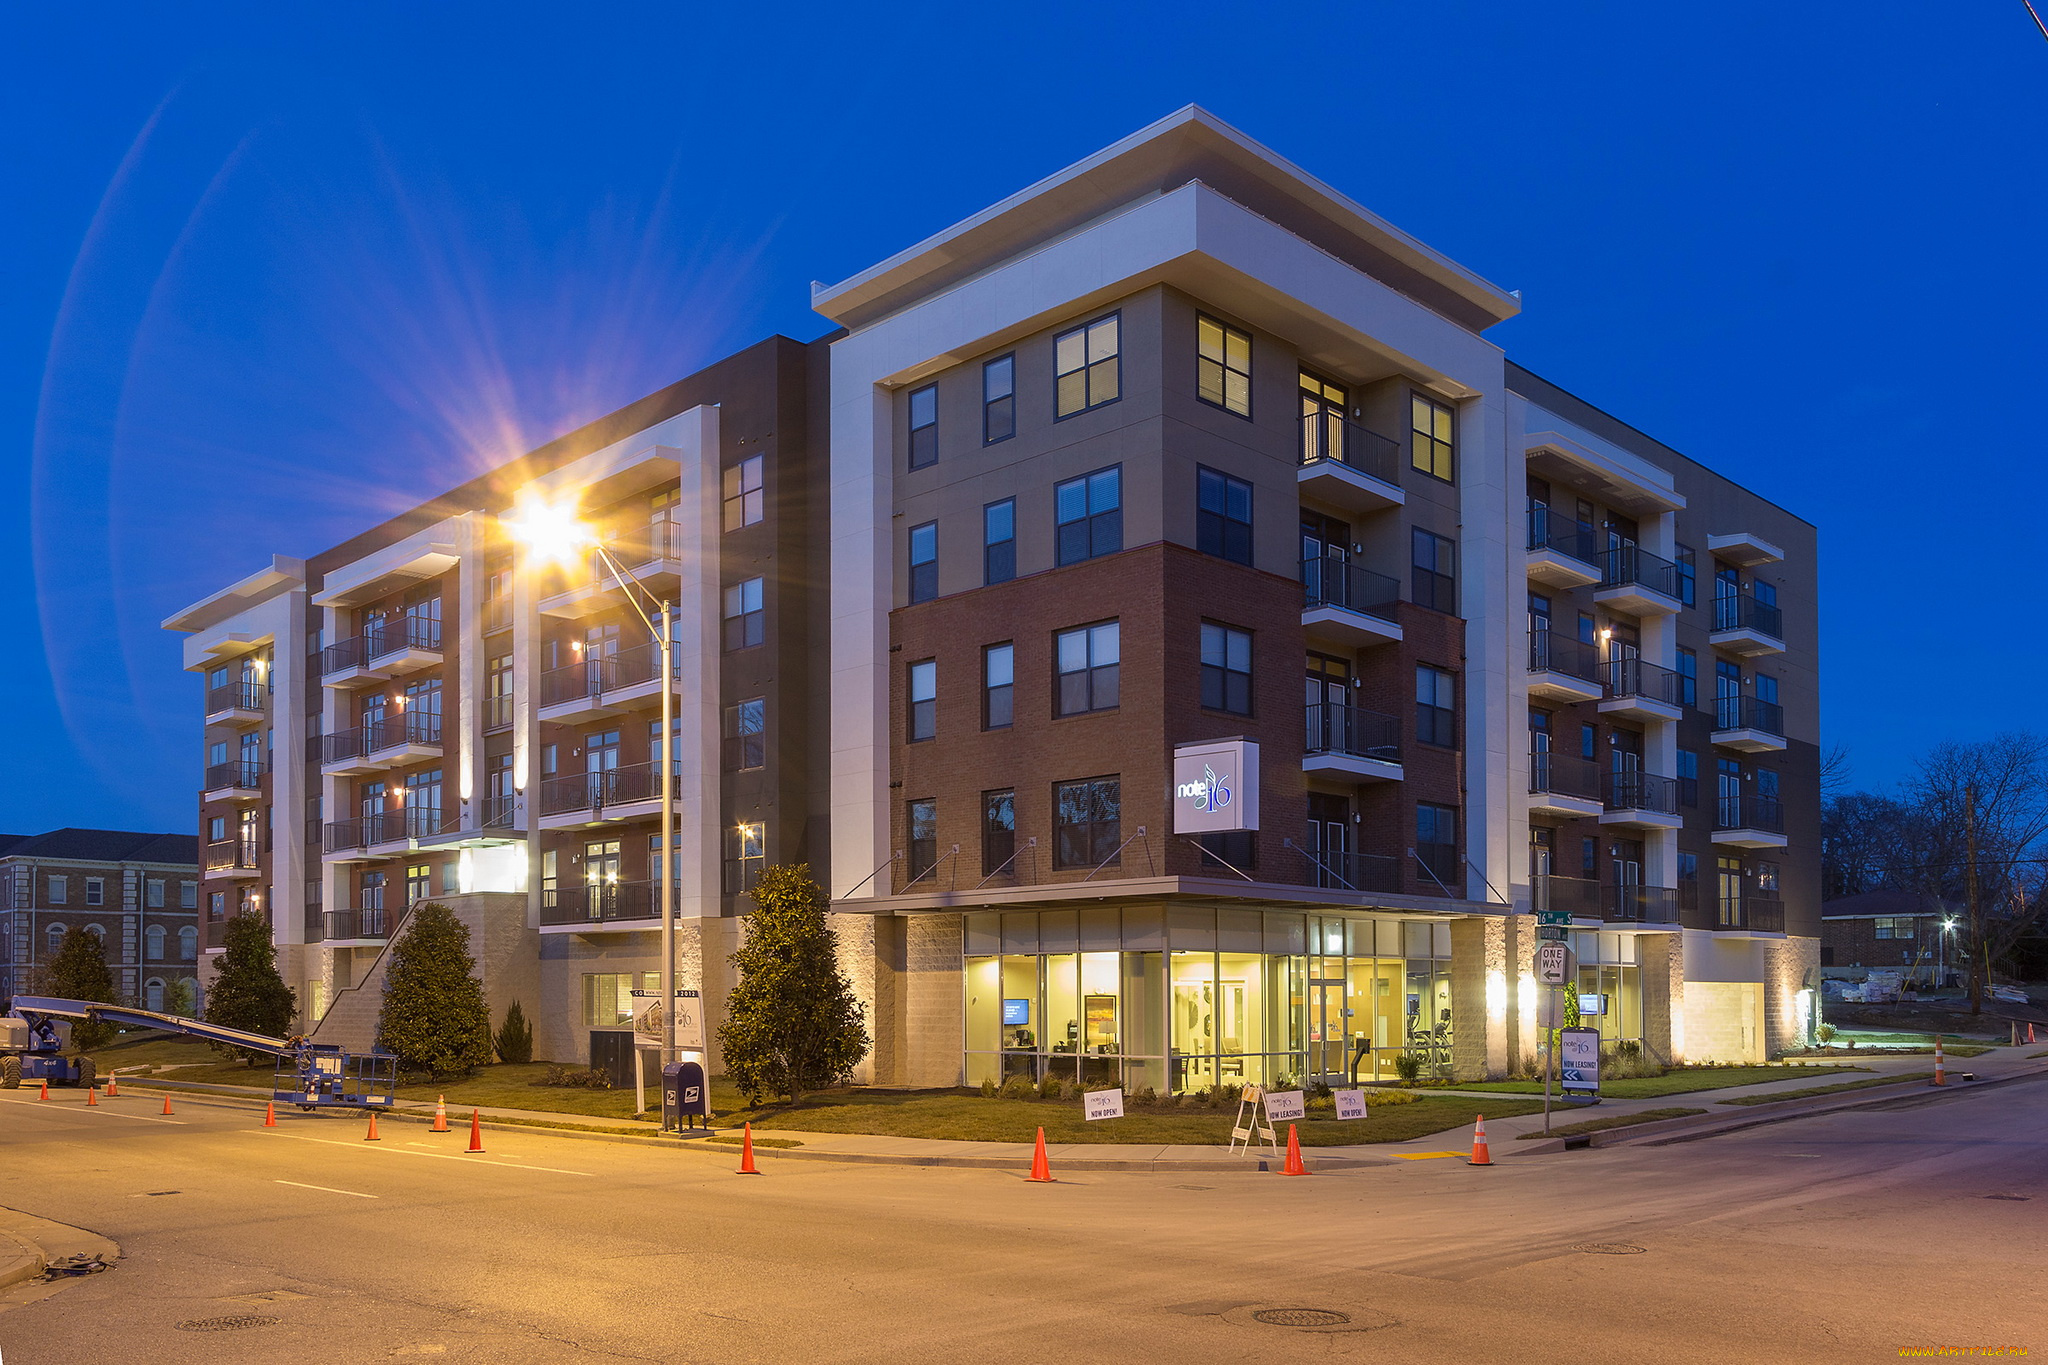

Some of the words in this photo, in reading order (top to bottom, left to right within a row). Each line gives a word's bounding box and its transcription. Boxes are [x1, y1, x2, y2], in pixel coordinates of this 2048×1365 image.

[1177, 779, 1206, 798] note
[1567, 913, 1572, 924] S
[1543, 949, 1562, 958] ONE
[1543, 960, 1562, 968] WAY
[1577, 1040, 1589, 1054] 16
[1564, 1060, 1575, 1068] NOW
[1575, 1060, 1597, 1069] LEASING!
[1091, 1110, 1102, 1118] NOW
[1103, 1108, 1118, 1117] OPEN!
[1280, 1109, 1303, 1119] LEASING!
